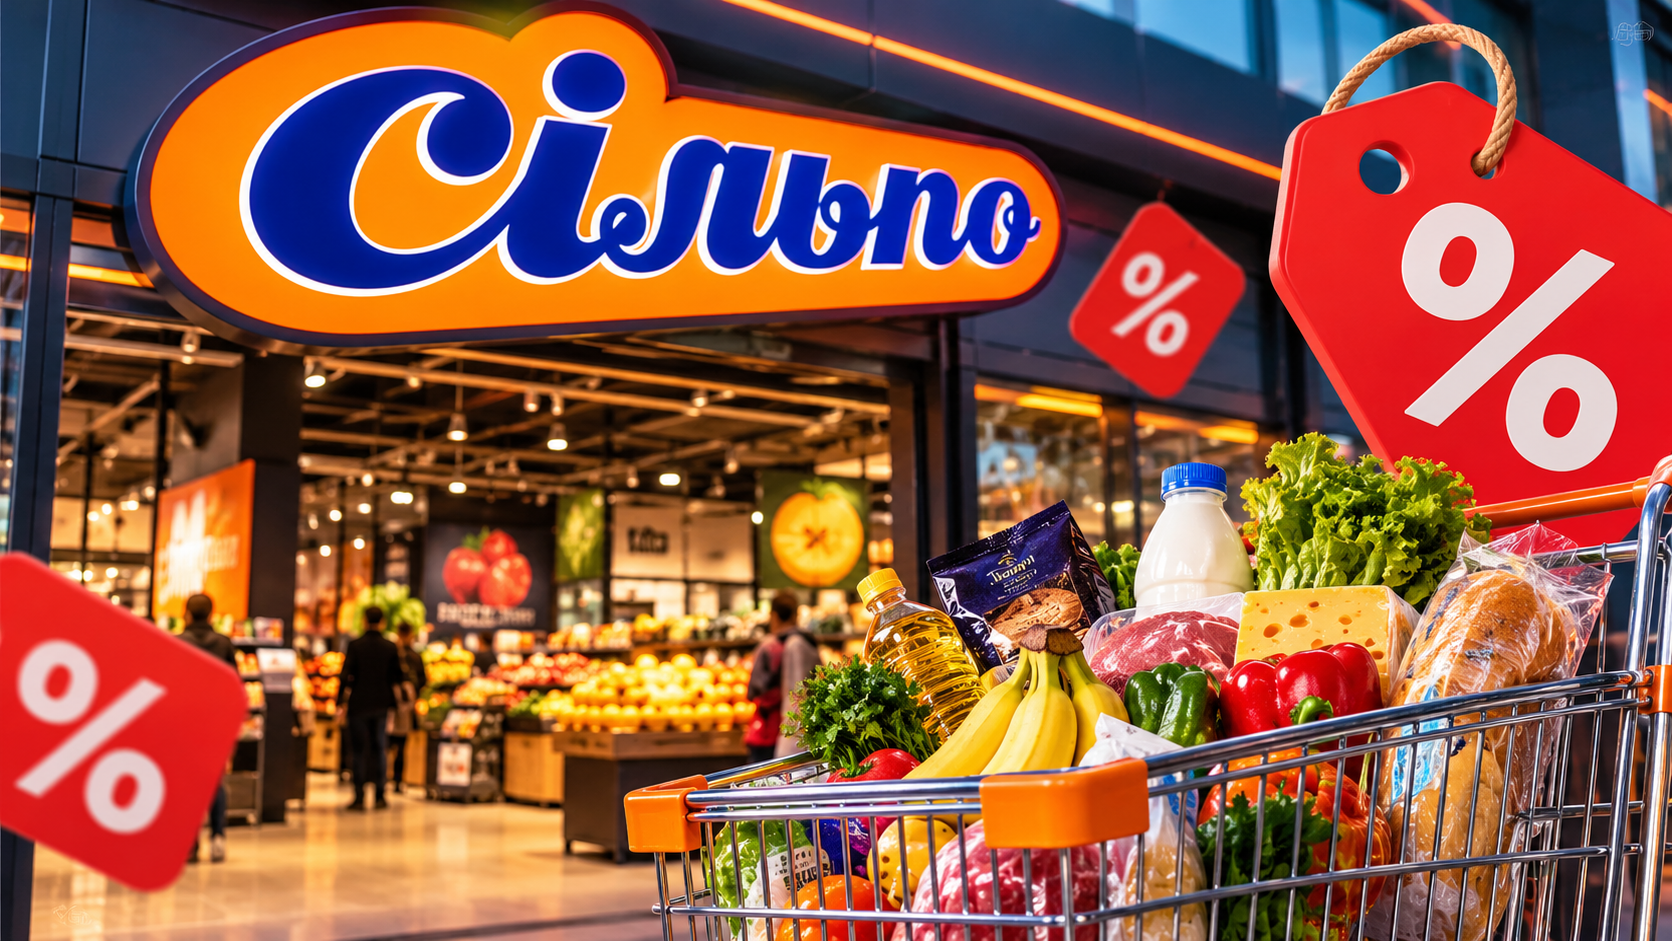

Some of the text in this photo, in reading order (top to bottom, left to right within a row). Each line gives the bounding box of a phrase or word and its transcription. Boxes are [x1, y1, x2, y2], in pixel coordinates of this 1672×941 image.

[239, 49, 1041, 296] Сільпо
[1112, 251, 1199, 357] %
[1401, 202, 1618, 472] %
[14, 639, 166, 835] %
